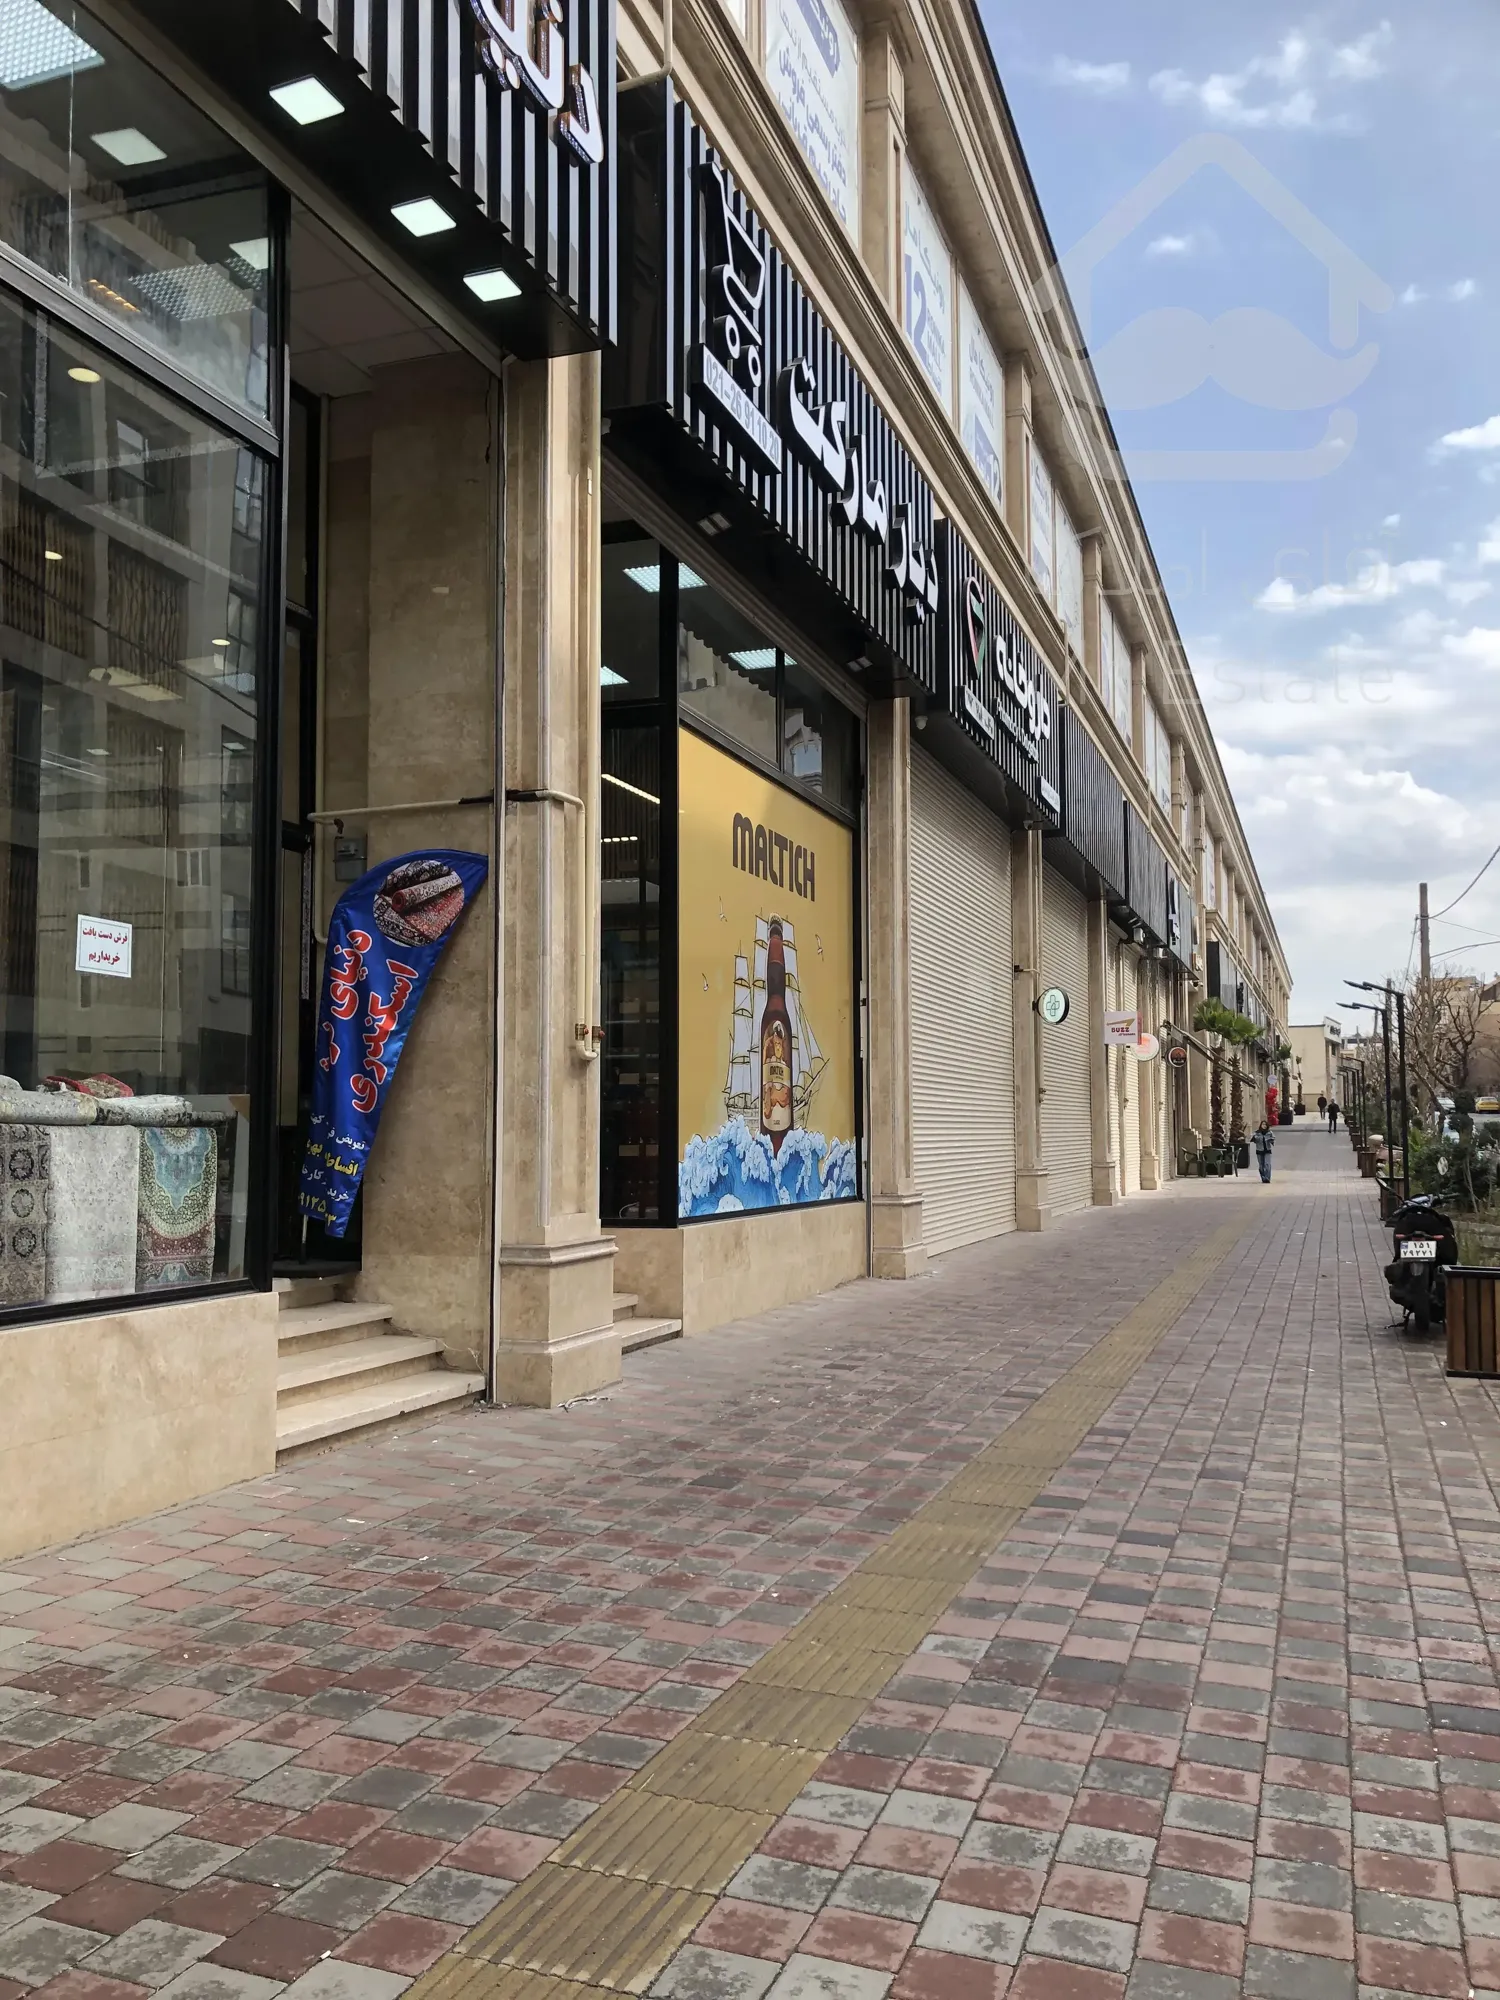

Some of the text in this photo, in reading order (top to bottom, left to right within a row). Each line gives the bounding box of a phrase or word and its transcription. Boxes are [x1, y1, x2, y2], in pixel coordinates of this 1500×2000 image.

[779, 46, 847, 187] دفتر رسمی فروش
[904, 252, 927, 368] 12
[789, 356, 888, 544] مارکت
[995, 634, 1050, 741] داروخانه
[732, 811, 816, 902] MALTICH
[82, 926, 128, 945] فرش دست بافت
[88, 950, 121, 965] خریداریم
[330, 929, 373, 1020] دنیای
[350, 959, 419, 1113] اسکندری
[335, 1132, 366, 1151] تعویض
